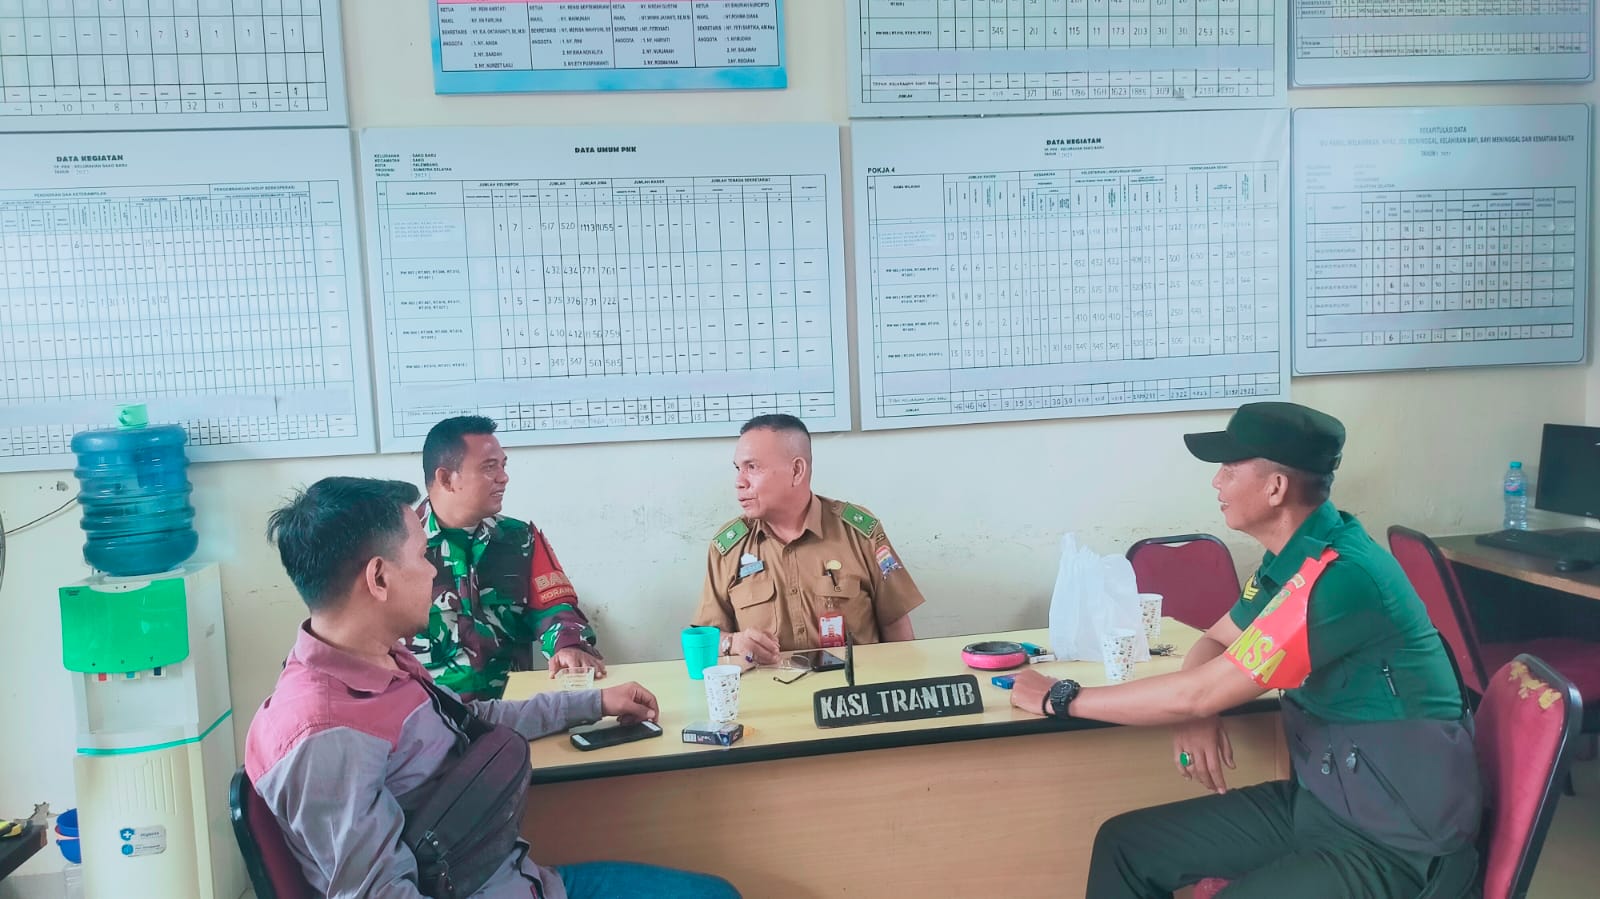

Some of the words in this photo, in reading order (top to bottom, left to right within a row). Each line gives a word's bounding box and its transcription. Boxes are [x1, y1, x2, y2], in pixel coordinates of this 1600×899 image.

[1066, 137, 1102, 145] KEGIATAN
[1491, 135, 1521, 143] MENINGGAL
[574, 145, 594, 154] DATA
[595, 145, 620, 154] UMUM
[620, 145, 637, 153] PKK
[56, 155, 79, 163] DATA
[80, 154, 124, 162] KEGIATAN
[819, 691, 870, 720] KASI
[876, 682, 975, 715] TRANTIB
